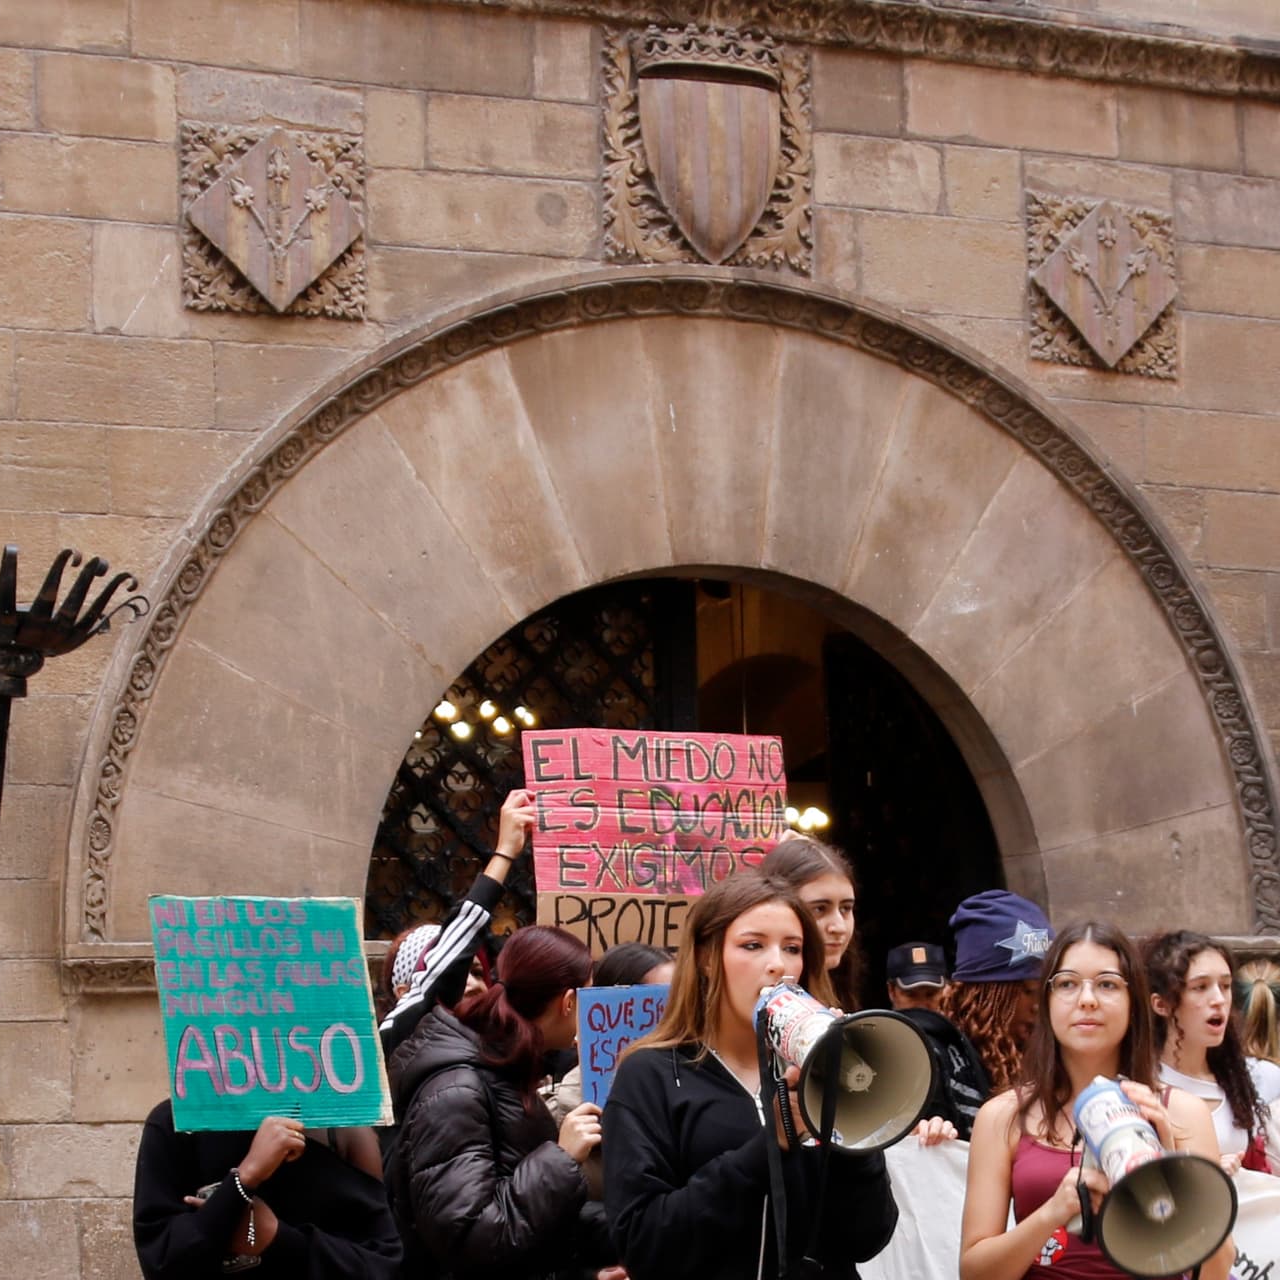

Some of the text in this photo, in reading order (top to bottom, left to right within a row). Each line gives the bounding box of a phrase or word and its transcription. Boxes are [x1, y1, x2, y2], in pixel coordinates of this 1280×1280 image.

[530, 736, 785, 784] EL MIEDO NO
[535, 784, 790, 840] ES EDUCACIÓN
[152, 901, 306, 927] NI EN LOS
[554, 895, 702, 958] PROTE
[158, 928, 346, 958] PASILLOS NI
[161, 958, 365, 989] EN LAS AULAS
[587, 997, 635, 1033] QUE
[175, 1023, 364, 1099] ABUSO
